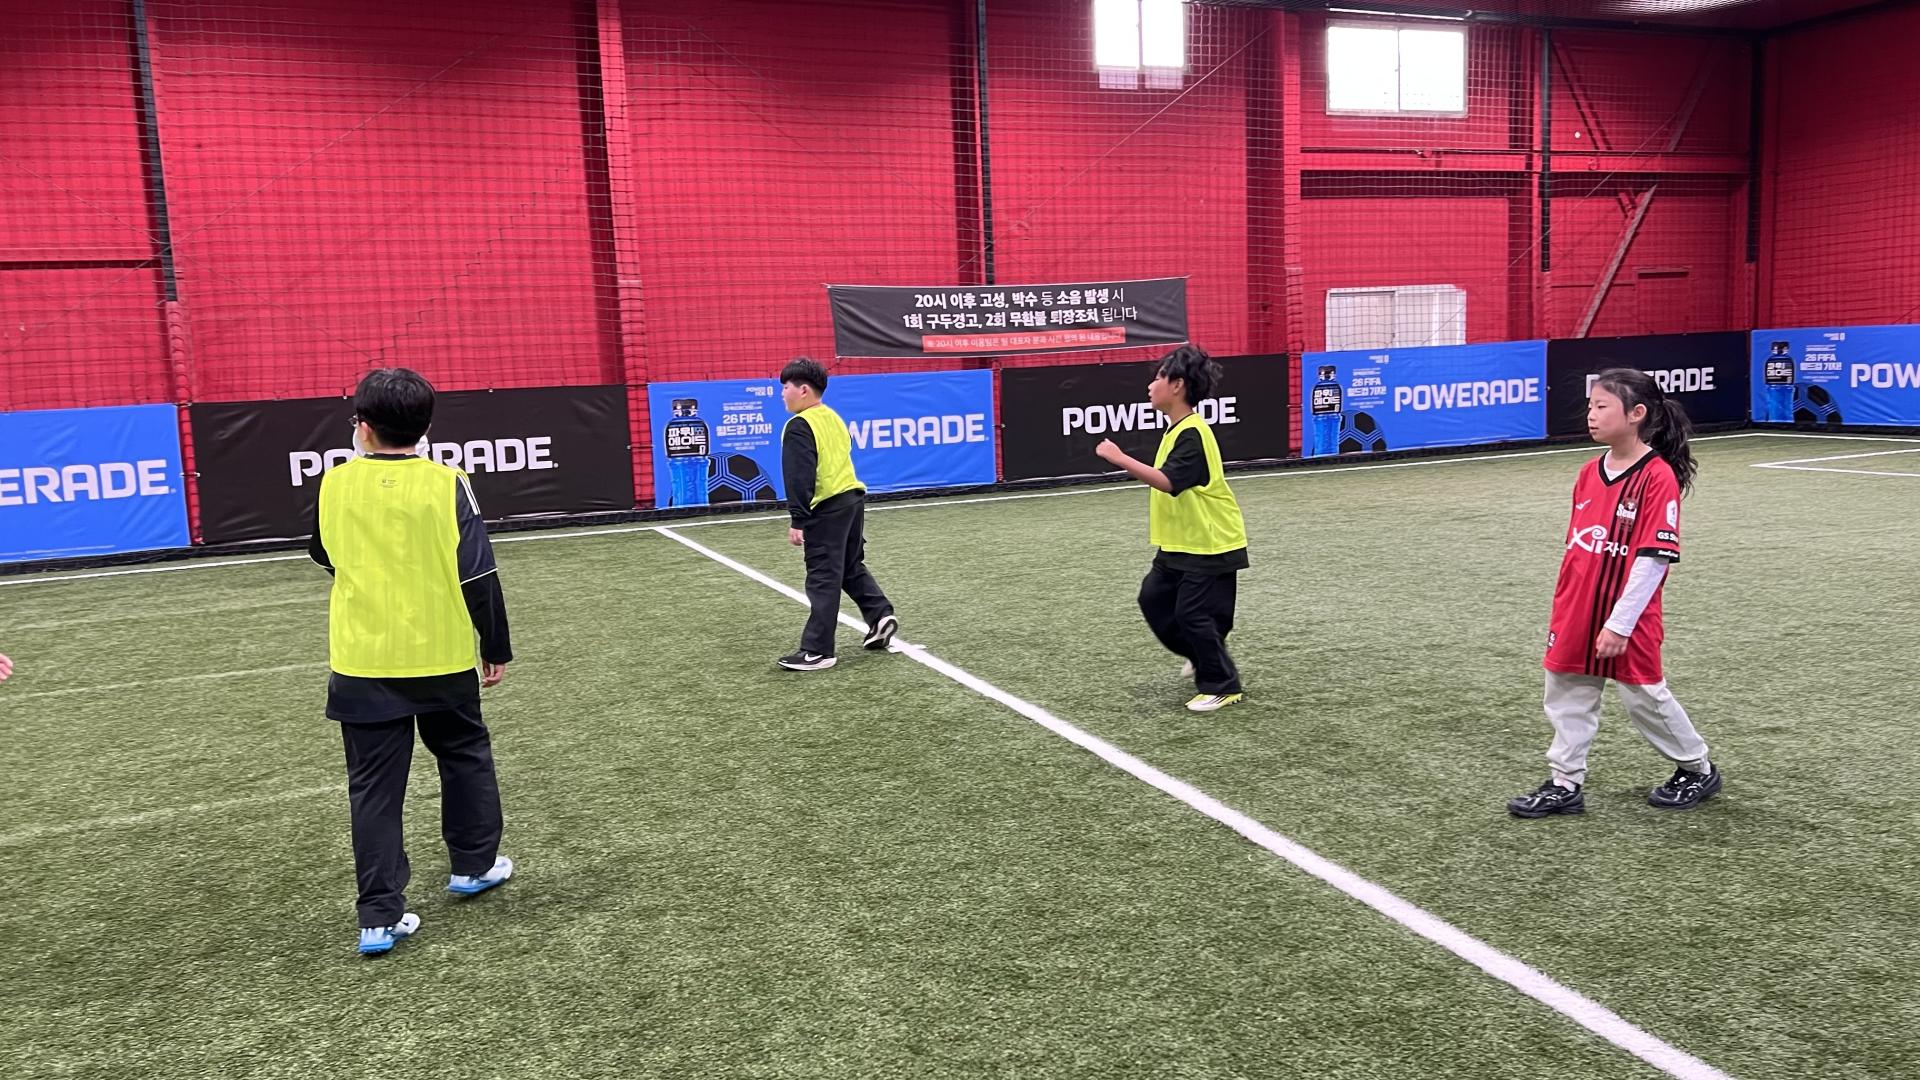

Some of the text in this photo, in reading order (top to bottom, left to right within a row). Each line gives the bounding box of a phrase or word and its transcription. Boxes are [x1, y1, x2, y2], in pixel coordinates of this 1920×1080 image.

[915, 288, 1124, 309] 20시 이후 고성, 박수 등 소음 발생 시
[903, 306, 1138, 330] 1회 구두경고, 2회 무환불 퇴장조치 됩니다
[1851, 363, 1920, 388] POW
[1395, 378, 1539, 412] POWERADE
[722, 413, 764, 424] 26 FIFA
[668, 436, 706, 446] 에이드
[289, 436, 553, 487] PORADE
[0, 459, 169, 506] ERADE
